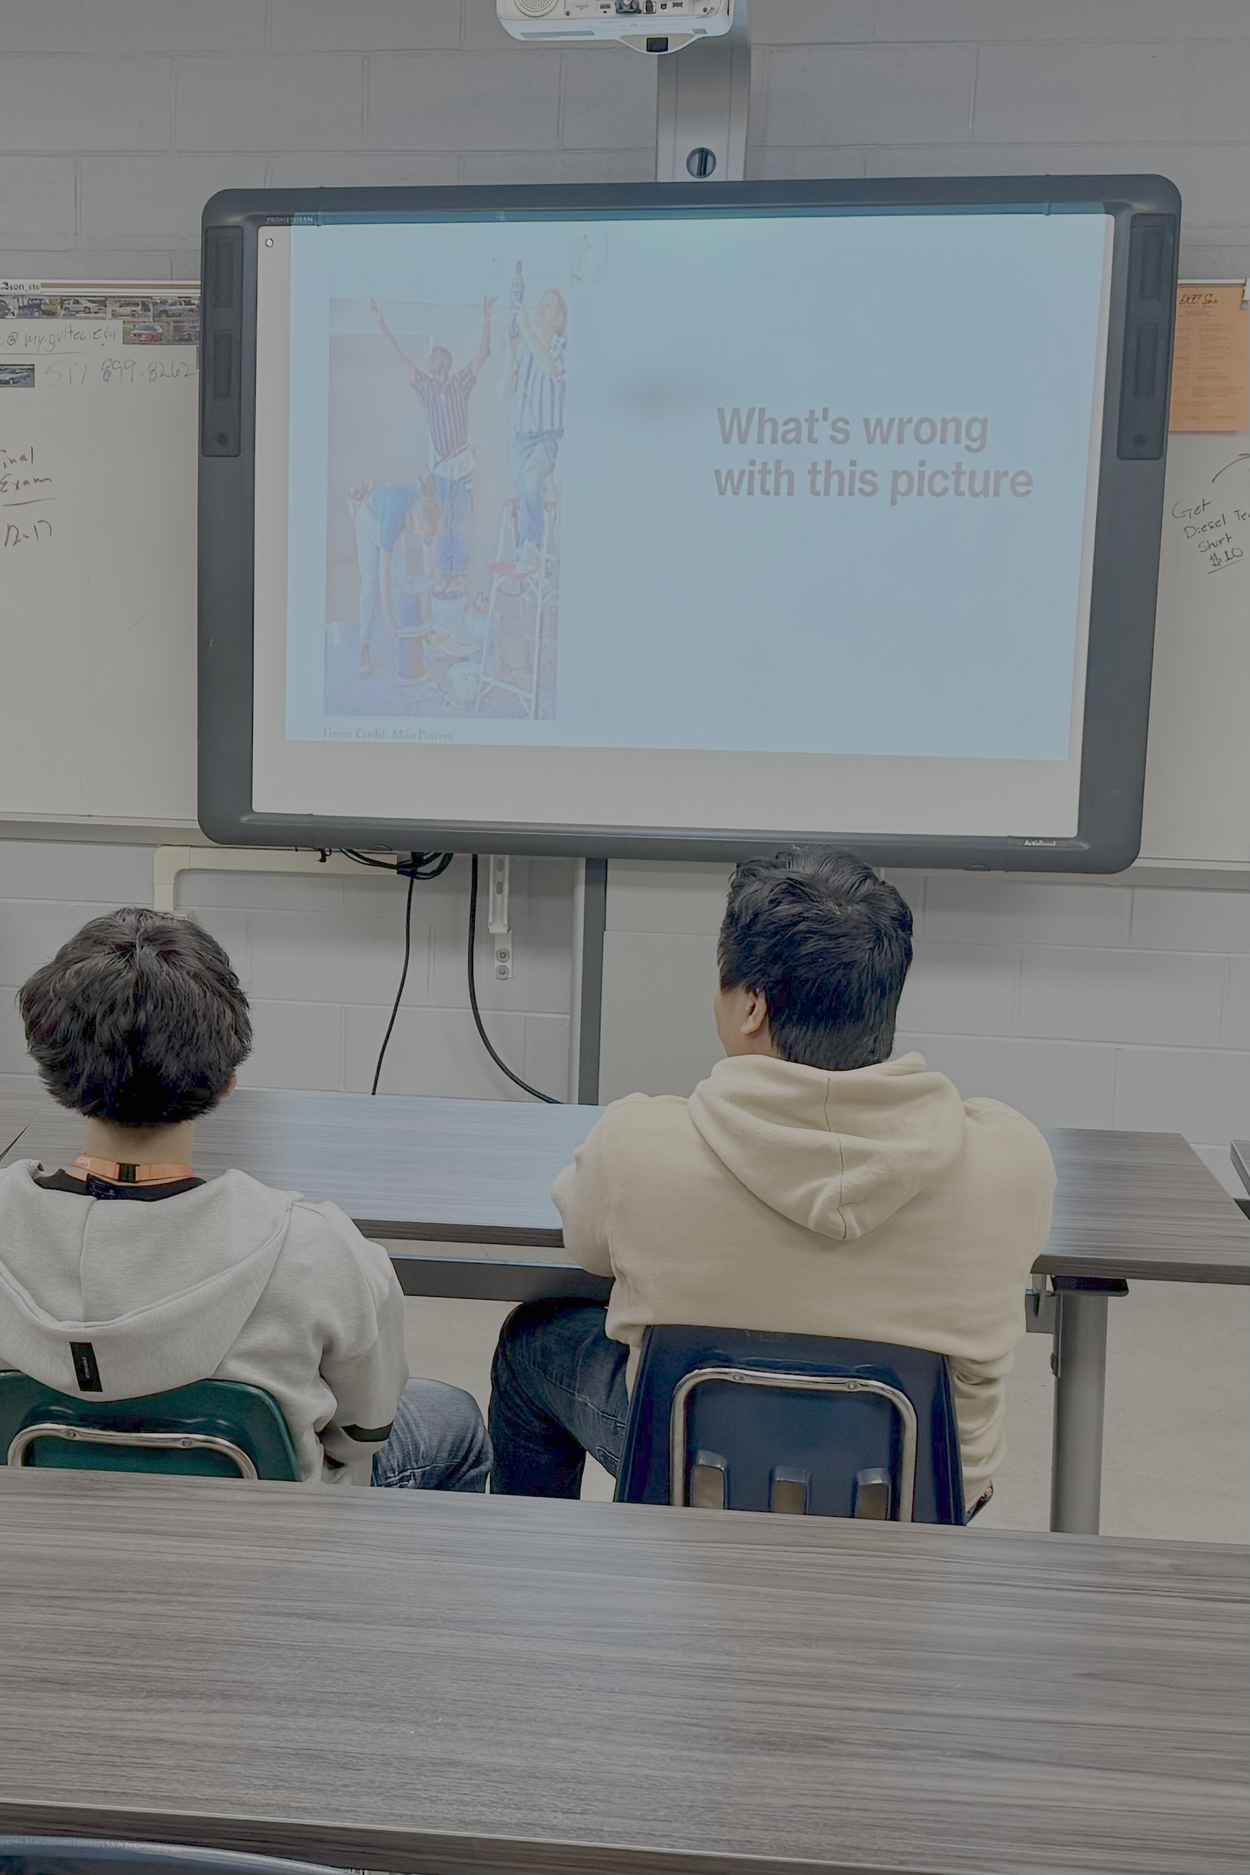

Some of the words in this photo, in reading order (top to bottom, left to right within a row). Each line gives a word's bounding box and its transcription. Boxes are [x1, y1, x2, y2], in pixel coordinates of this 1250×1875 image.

[717, 407, 850, 444] What's
[862, 416, 988, 453] wrong
[0, 473, 52, 493] Exam
[714, 459, 795, 496] with
[807, 459, 879, 496] this
[890, 459, 1033, 505] picture
[1171, 498, 1212, 519] Get
[1183, 513, 1226, 539] Diesel
[1209, 547, 1243, 567] $10
[323, 727, 353, 740] Figure
[392, 729, 417, 740] Mike
[418, 729, 453, 741] Powers
